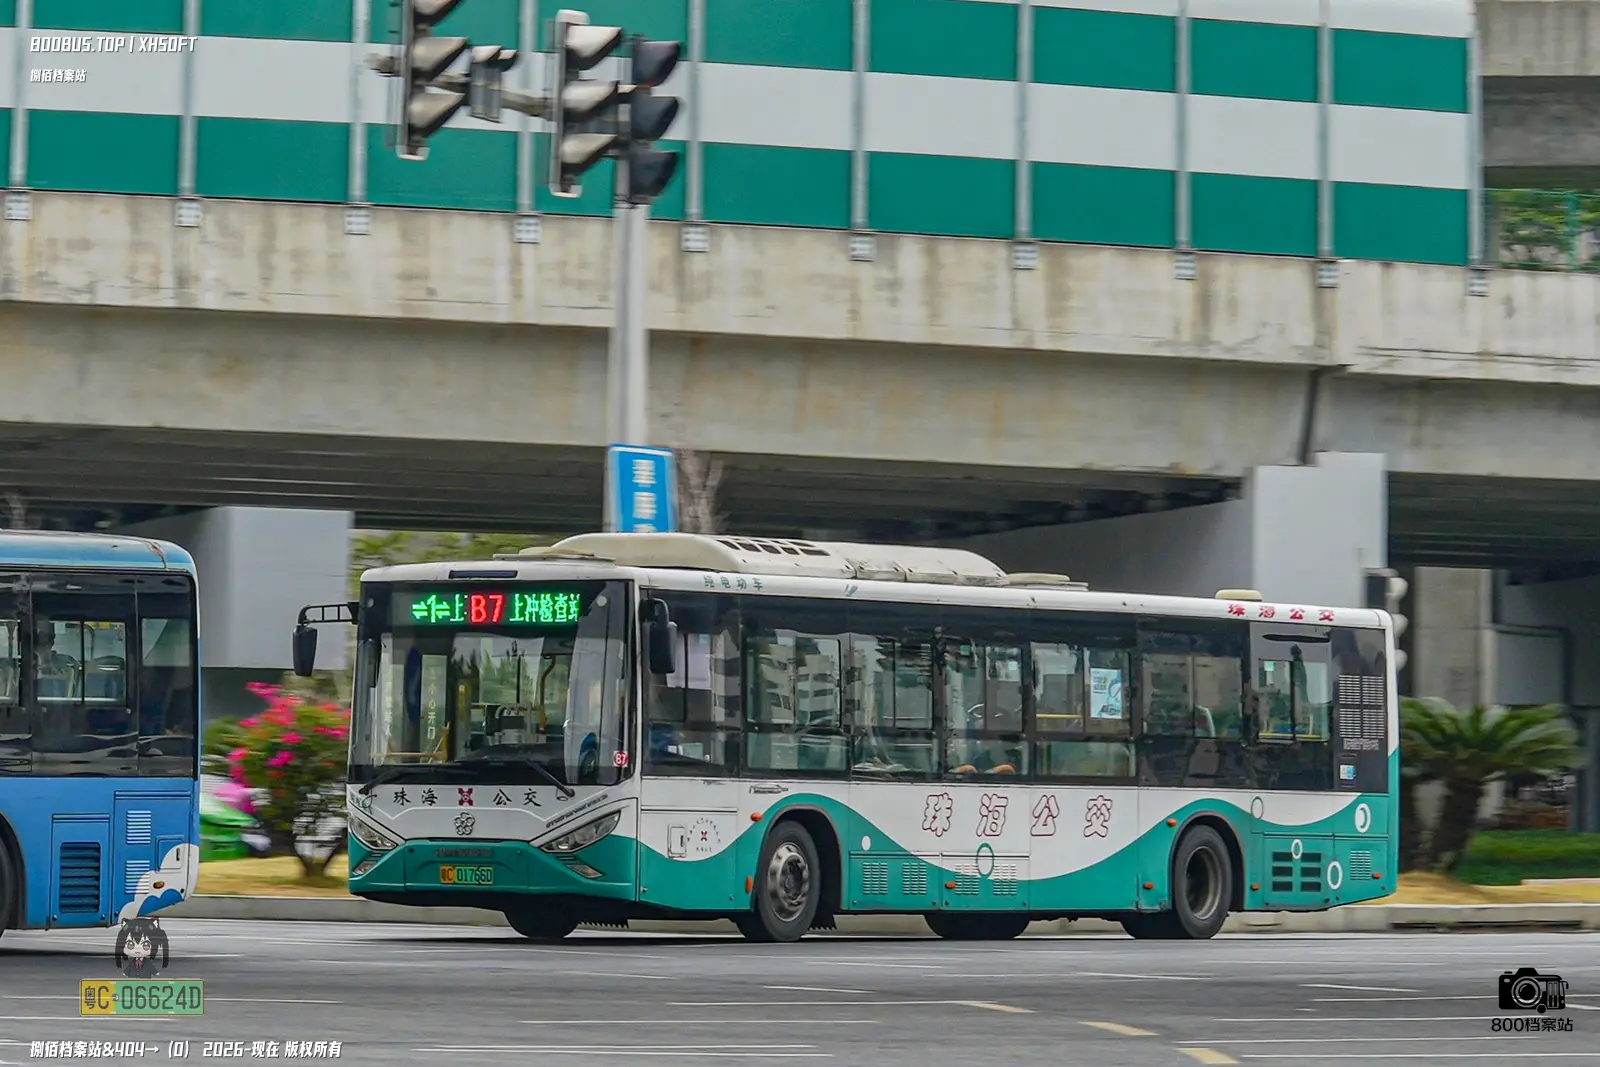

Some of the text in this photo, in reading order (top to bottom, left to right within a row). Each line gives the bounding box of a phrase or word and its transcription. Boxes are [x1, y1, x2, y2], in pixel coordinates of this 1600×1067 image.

[470, 594, 505, 623] B7
[1228, 603, 1335, 622] 珠海公交
[922, 792, 1113, 838] 珠海公交
